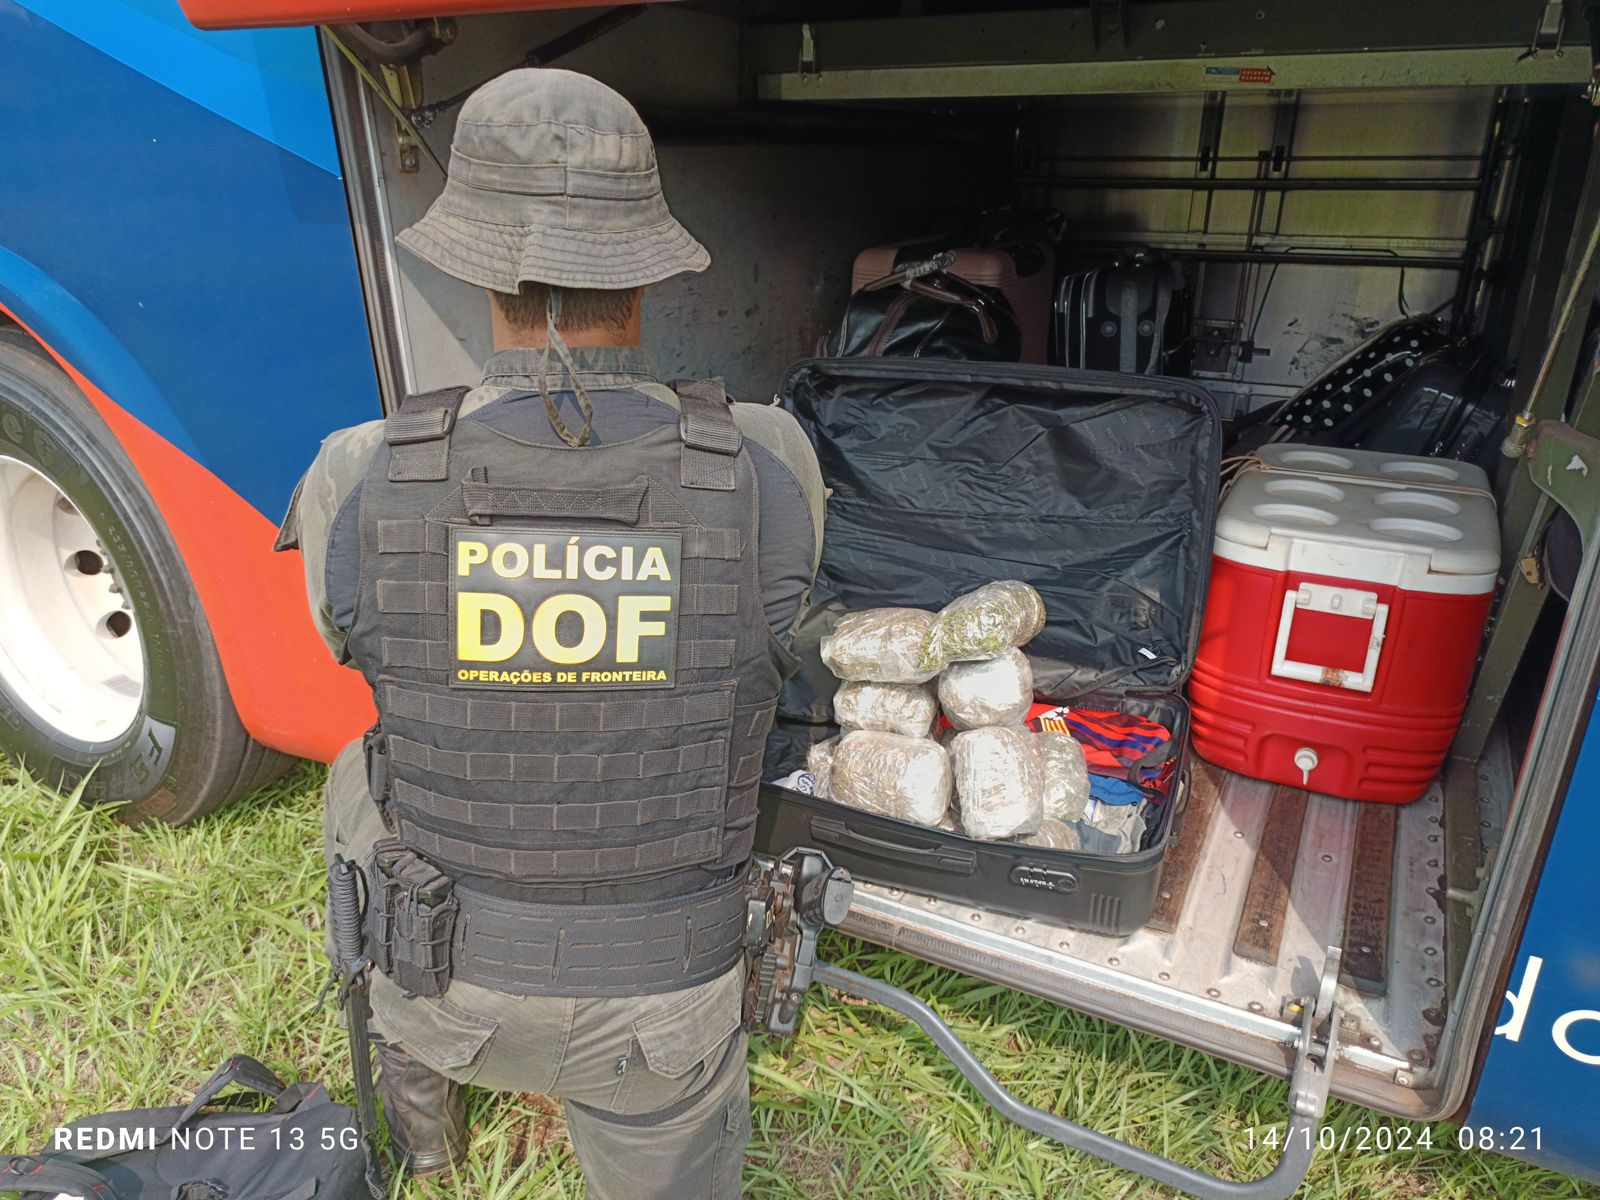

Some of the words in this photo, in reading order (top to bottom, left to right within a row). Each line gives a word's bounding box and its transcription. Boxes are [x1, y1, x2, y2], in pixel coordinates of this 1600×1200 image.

[457, 536, 672, 581] POLÍCIA
[457, 591, 672, 664] DOF
[457, 669, 553, 685] OPERAÇÕES
[556, 671, 577, 683] DE
[581, 670, 667, 683] FRONTEIRA
